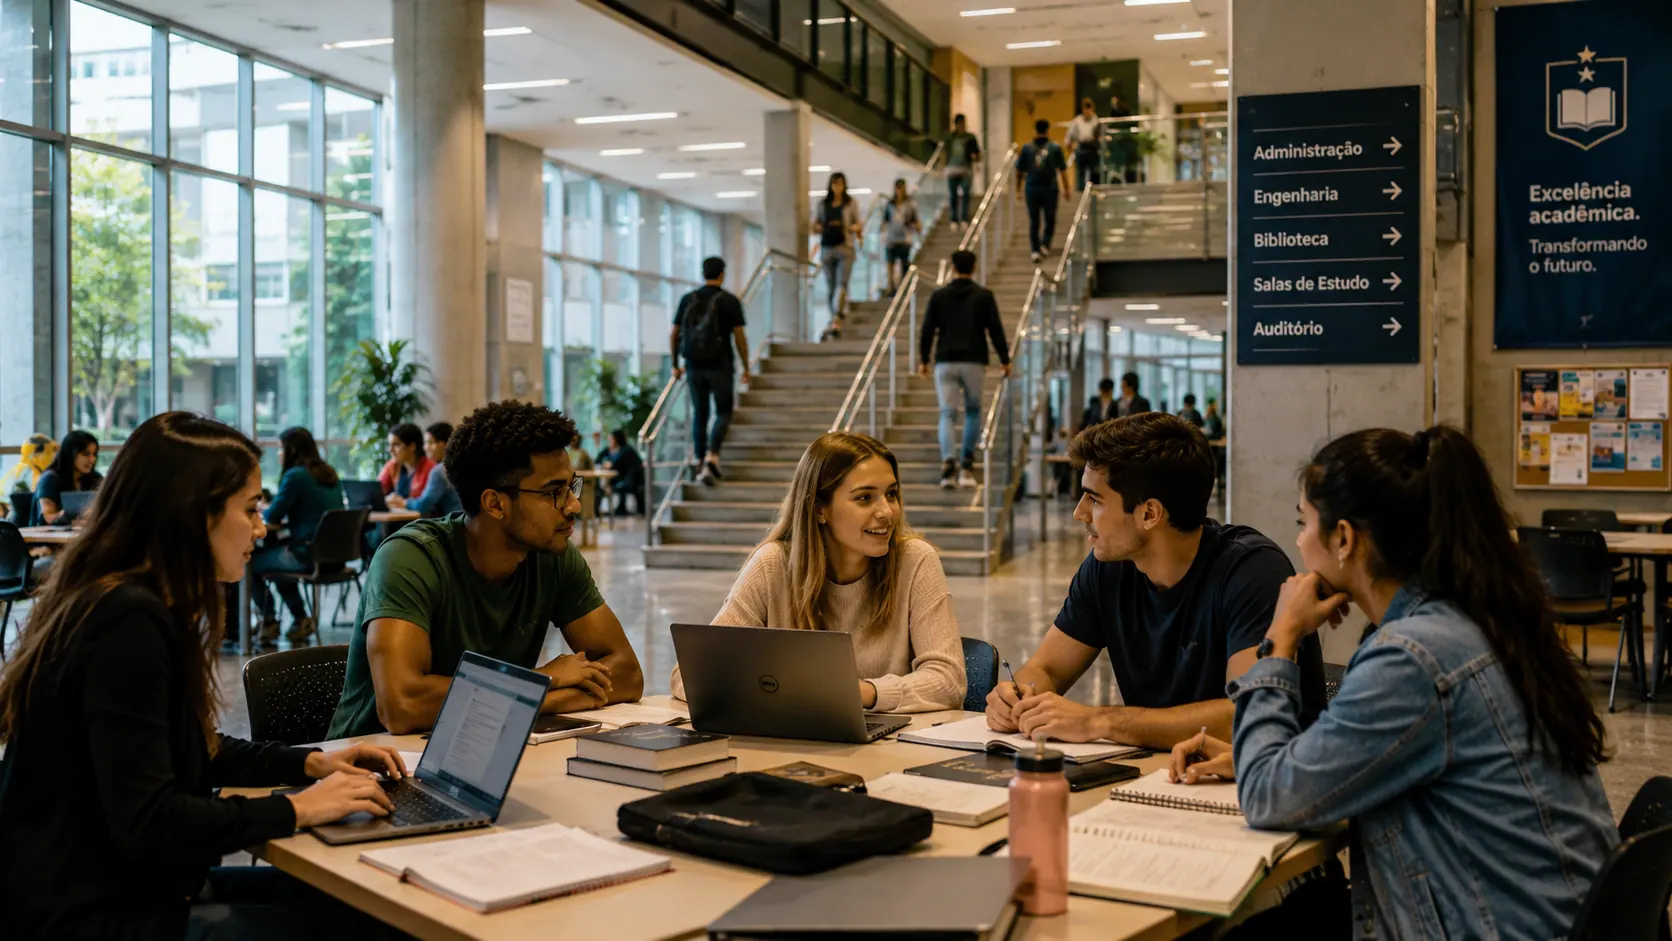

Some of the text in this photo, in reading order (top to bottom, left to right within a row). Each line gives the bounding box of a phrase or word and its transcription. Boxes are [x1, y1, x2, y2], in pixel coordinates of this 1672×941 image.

[1253, 187, 1339, 206] Engenharia
[1529, 181, 1632, 203] Excelência
[1529, 204, 1641, 225] acadêmica.
[1253, 232, 1329, 248] Biblioteca
[1528, 236, 1648, 254] Transformando
[1528, 258, 1597, 274] o futuro.
[1253, 275, 1370, 292] Salas de Estudo
[1253, 321, 1324, 337] Auditório
